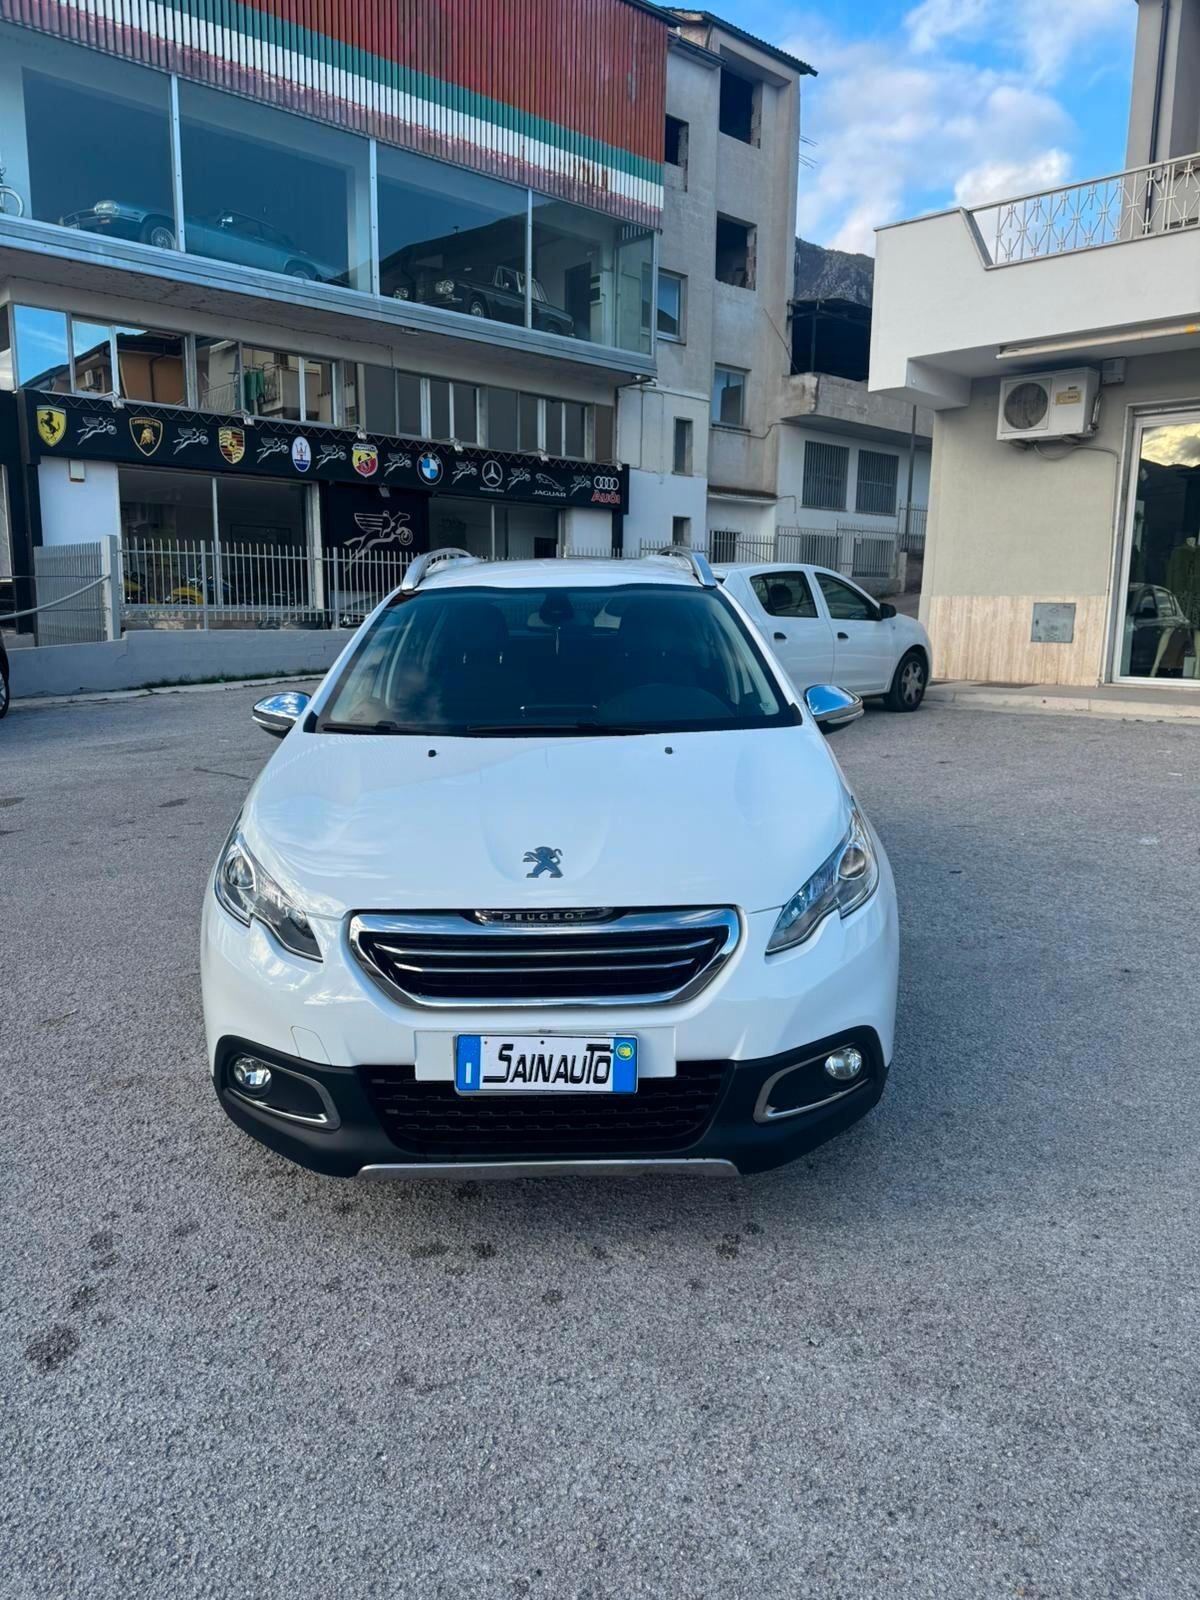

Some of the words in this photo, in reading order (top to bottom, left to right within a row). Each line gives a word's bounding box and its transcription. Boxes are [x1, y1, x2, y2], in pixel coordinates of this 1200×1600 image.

[532, 489, 567, 498] JAGUAR
[591, 490, 621, 504] Audi
[502, 911, 586, 921] PEUGEOT
[482, 1043, 612, 1084] SAINAUTO
